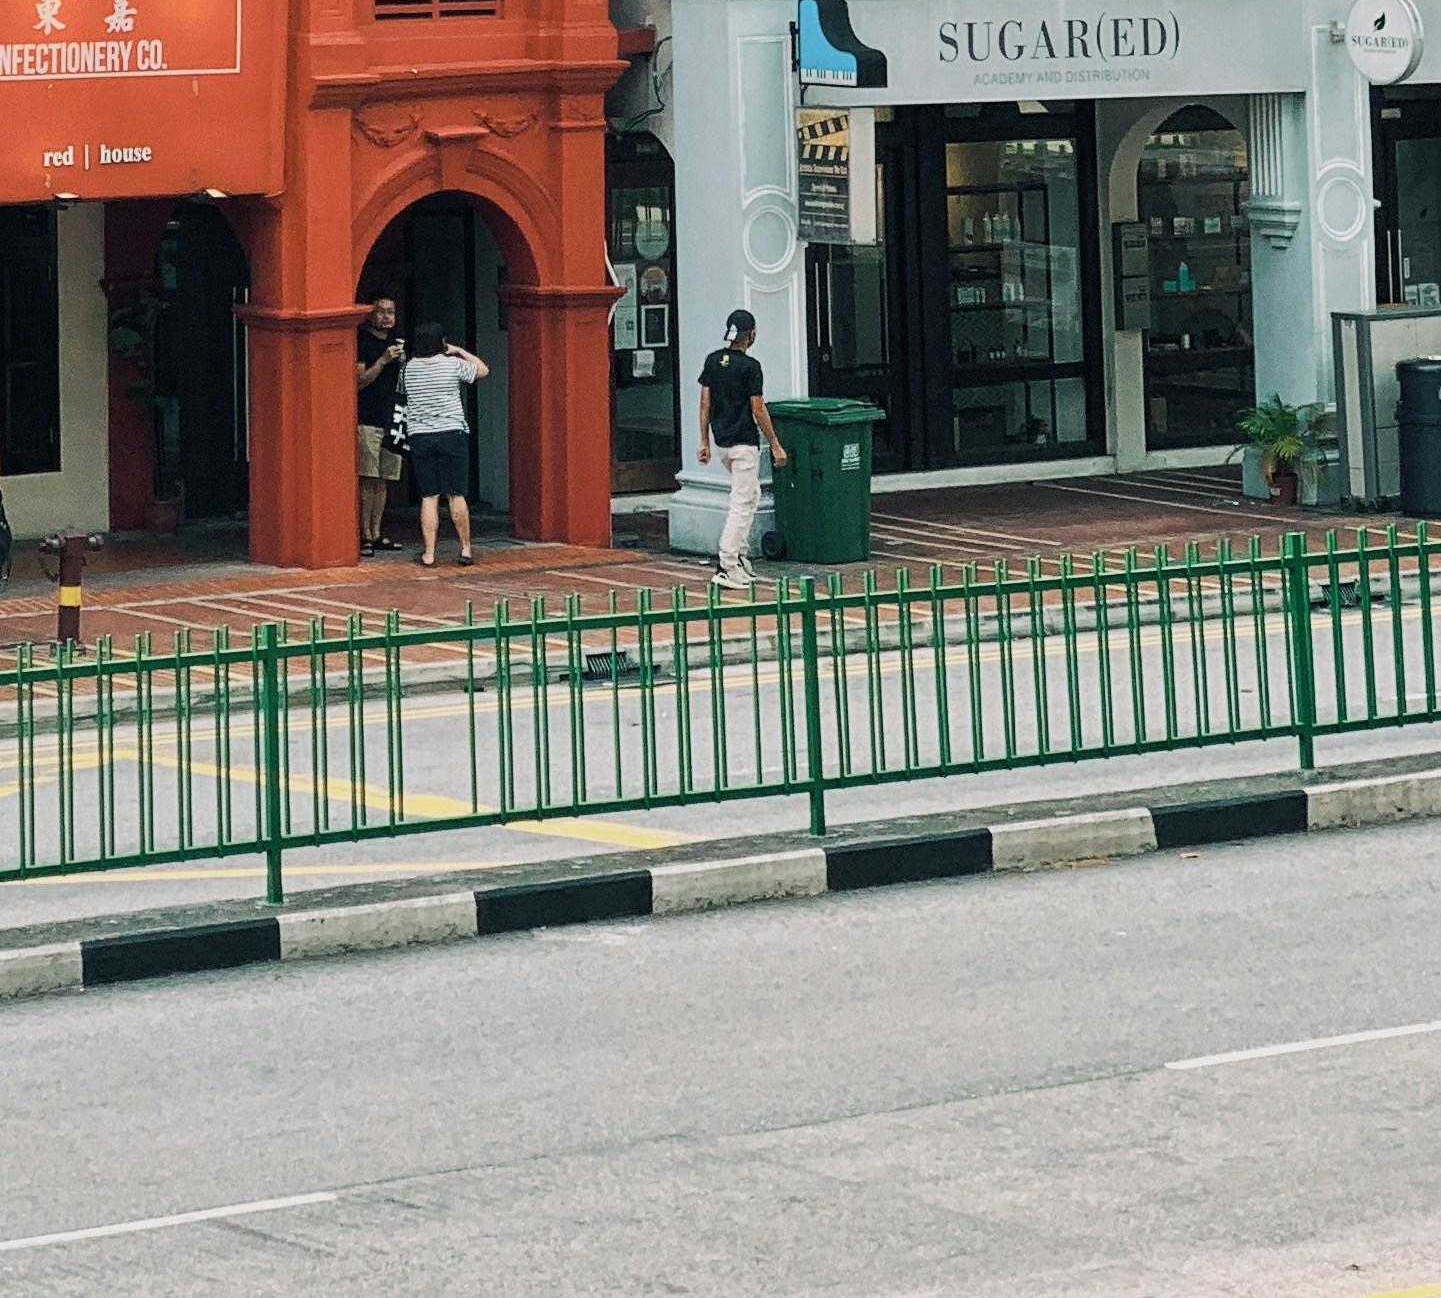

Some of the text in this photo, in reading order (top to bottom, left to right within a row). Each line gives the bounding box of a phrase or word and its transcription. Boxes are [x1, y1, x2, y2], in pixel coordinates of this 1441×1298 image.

[938, 10, 1180, 63] SUGAR(ED)
[1351, 35, 1409, 49] SUGAR(ED)
[136, 38, 168, 71] CO.
[973, 67, 1151, 86] ACADEMY AND DISTRIBUTION
[43, 145, 75, 168] red
[99, 143, 153, 164] house
